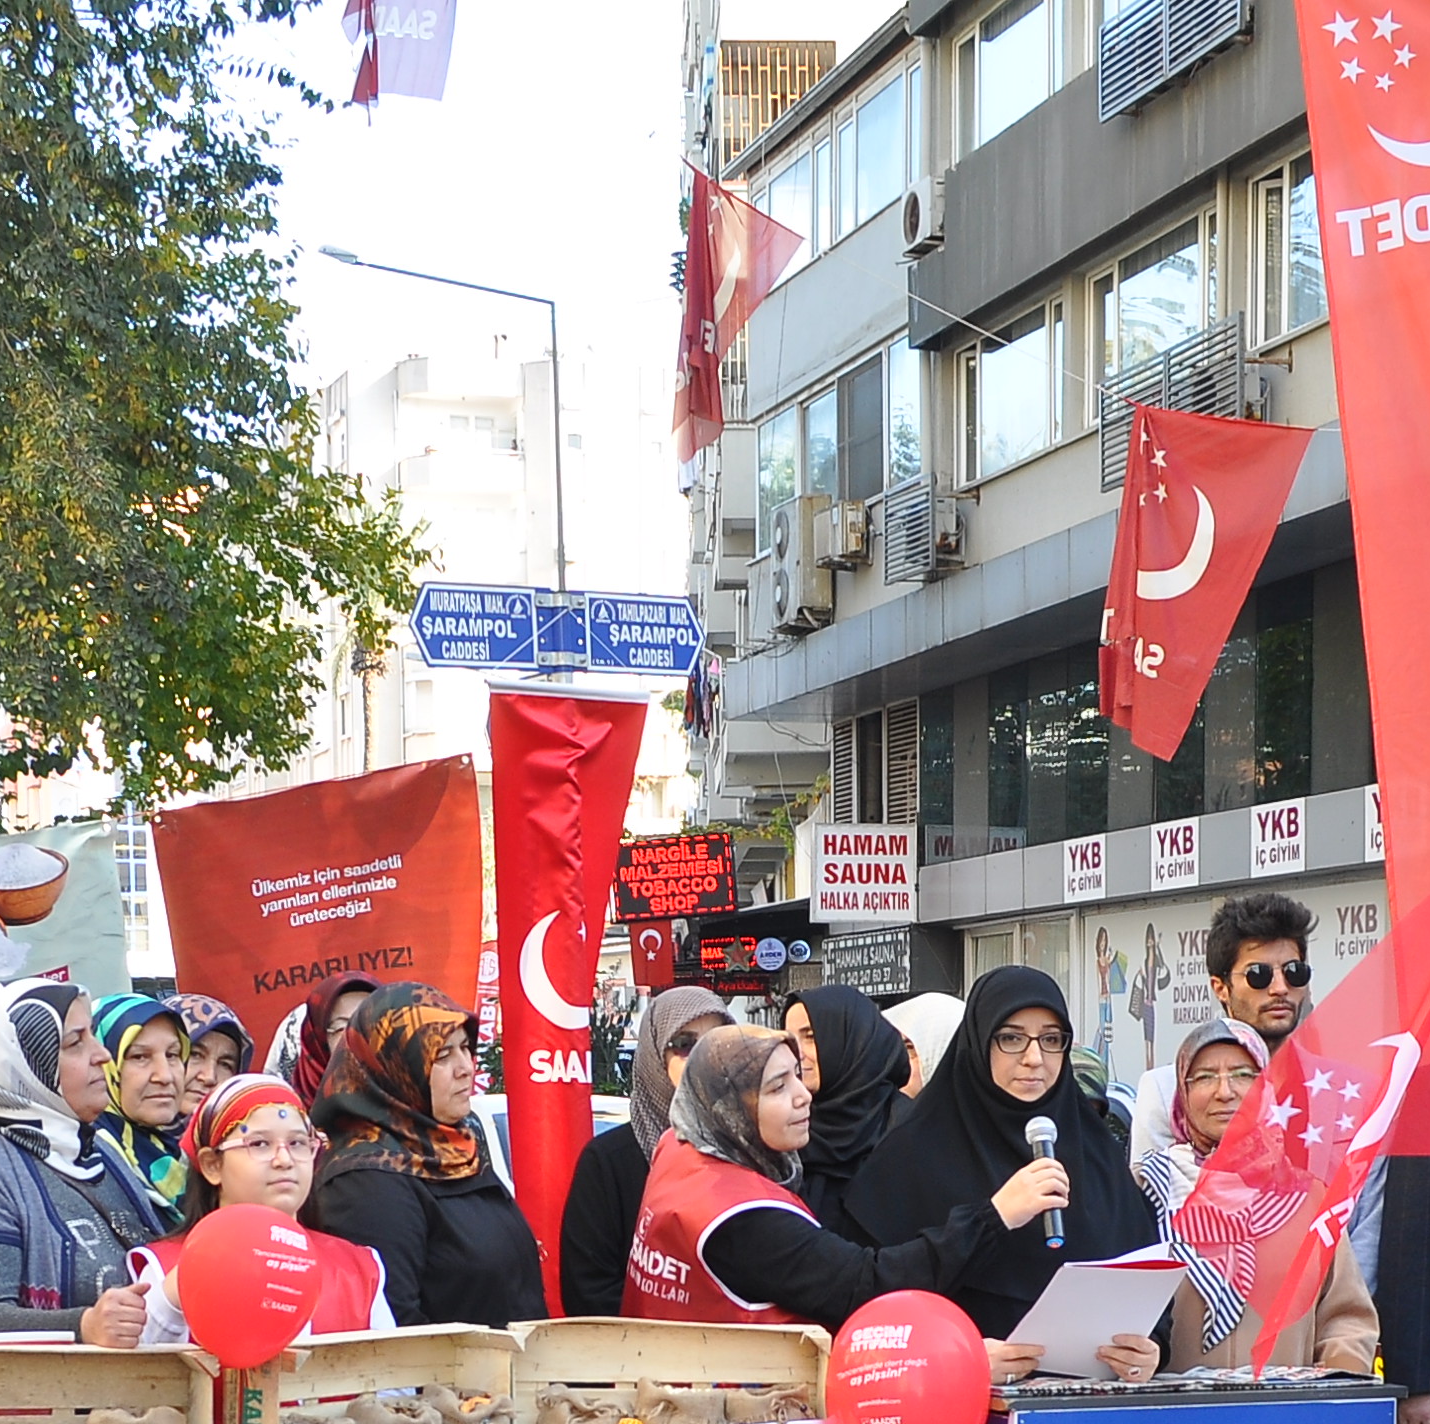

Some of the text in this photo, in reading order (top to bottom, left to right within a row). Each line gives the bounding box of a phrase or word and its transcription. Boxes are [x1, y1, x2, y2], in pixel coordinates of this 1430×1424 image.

[430, 590, 482, 618] MURATPAŞA
[421, 615, 517, 640] ŞARAMPOL
[609, 624, 697, 647] ŞARAMPOL
[442, 637, 490, 661] CADDESİ
[629, 646, 674, 668] CADDESİ
[1257, 807, 1299, 842] YKB
[631, 842, 708, 865] NARGİLE
[823, 834, 908, 855] HAMAM
[1156, 825, 1194, 859] YKB
[1068, 841, 1101, 873] YKB
[1255, 842, 1300, 869] İÇ GİYİM
[252, 854, 403, 898] Ülkemiz için saadetli
[619, 855, 725, 882] MALZEMESİ
[823, 863, 907, 885] SAUNA
[1155, 857, 1195, 883] İÇ GİYİM
[628, 874, 717, 898] TOBACCO
[1078, 873, 1102, 891] GİYİM
[261, 876, 398, 917] yarınları ellerimizle
[649, 892, 699, 912] SHOP
[820, 891, 910, 916] HALKA AÇIKTIR
[289, 898, 372, 928] üreteceğiz!
[1336, 905, 1378, 934] YKB
[1187, 957, 1206, 976] GİYİ
[1173, 982, 1210, 1003] DÜNYA
[529, 1050, 593, 1083] SAA
